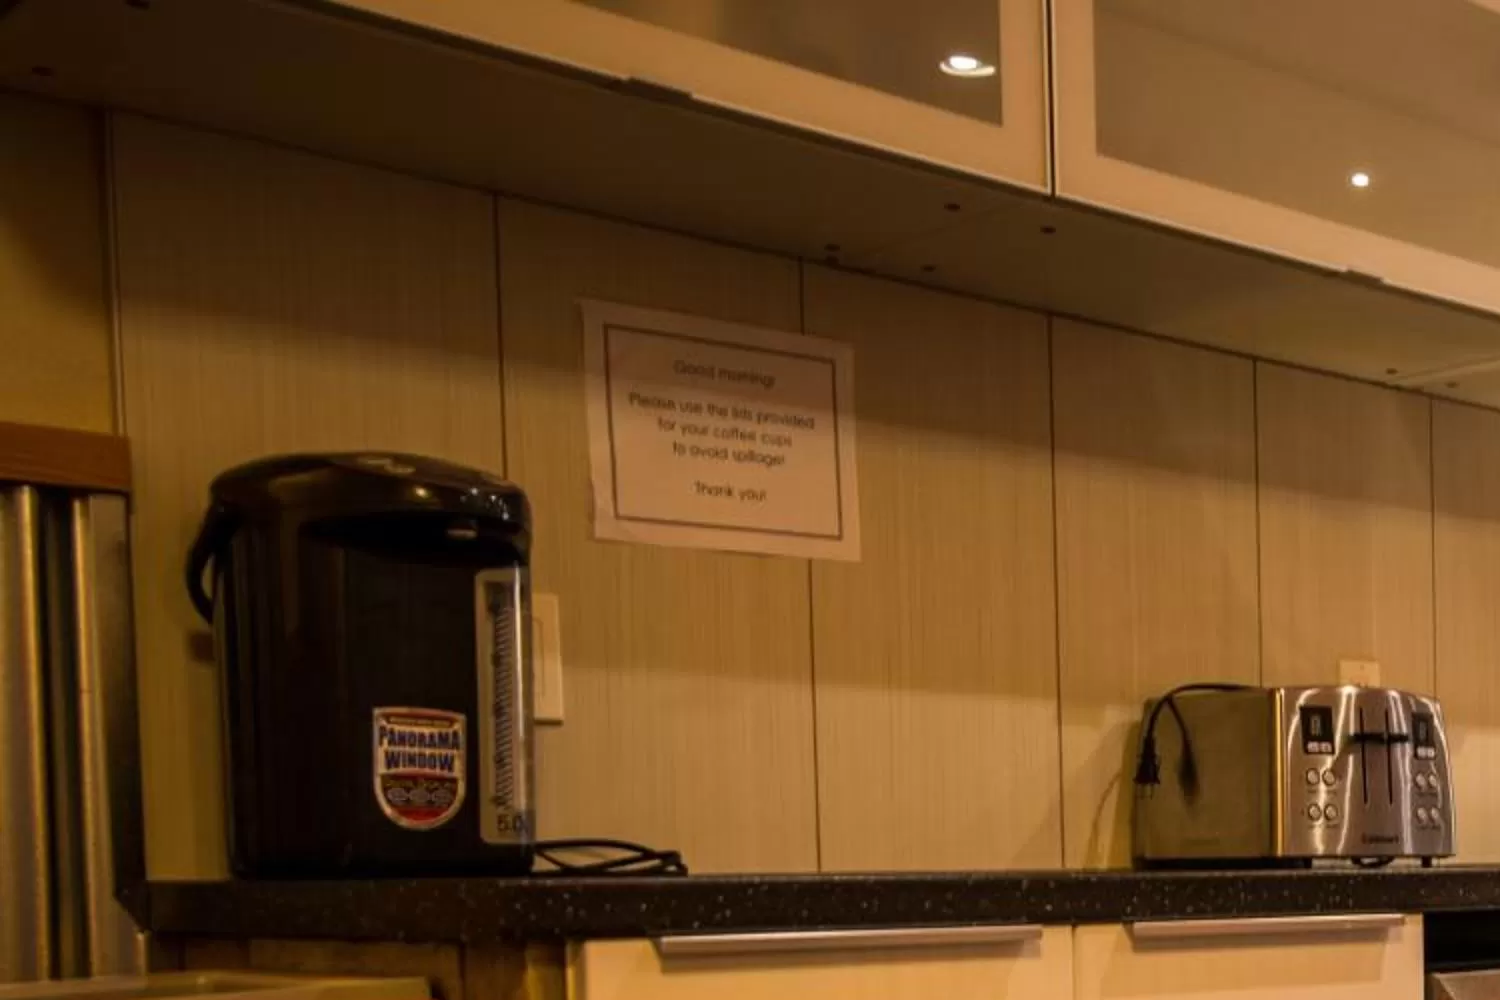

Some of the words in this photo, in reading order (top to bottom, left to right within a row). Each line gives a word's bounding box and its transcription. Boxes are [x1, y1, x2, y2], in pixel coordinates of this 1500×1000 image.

[673, 359, 715, 380] Good
[628, 391, 677, 411] Please
[679, 401, 703, 414] use
[707, 402, 729, 418] the
[756, 410, 816, 430] provided
[657, 415, 677, 432] for
[679, 423, 709, 438] your
[713, 425, 757, 442] coffee
[761, 432, 793, 449] cups
[672, 439, 687, 456] to
[689, 444, 729, 461] avoid
[693, 480, 734, 497] Thank
[379, 725, 461, 749] PANORAMA
[384, 750, 455, 771] WINDOW
